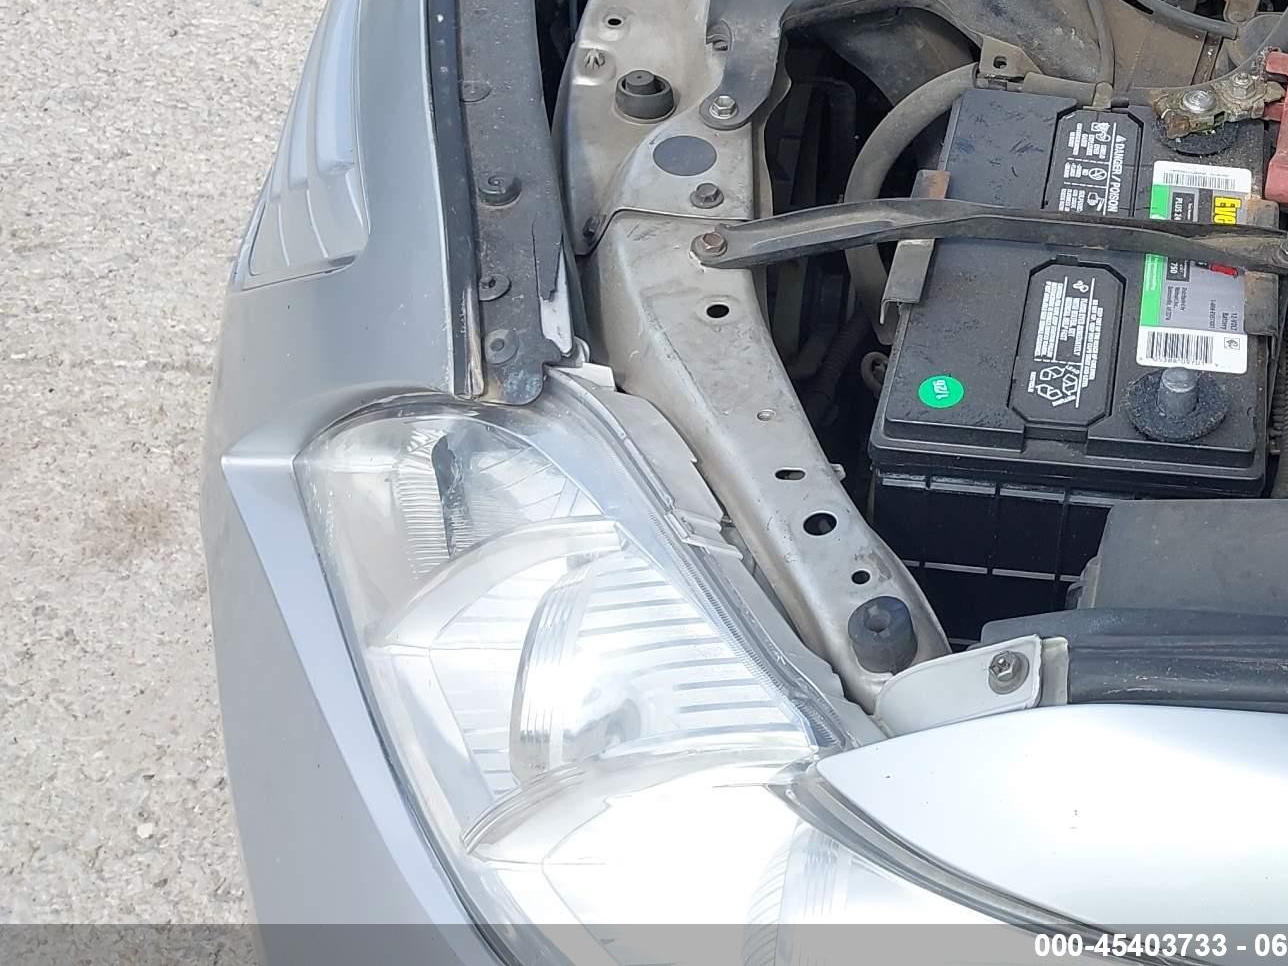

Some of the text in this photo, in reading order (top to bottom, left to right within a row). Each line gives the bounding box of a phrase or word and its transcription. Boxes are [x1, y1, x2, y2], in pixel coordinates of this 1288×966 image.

[1110, 142, 1126, 176] DANGER
[1107, 182, 1121, 212] POISON
[1174, 197, 1182, 212] PLUS
[1170, 261, 1178, 274] 750
